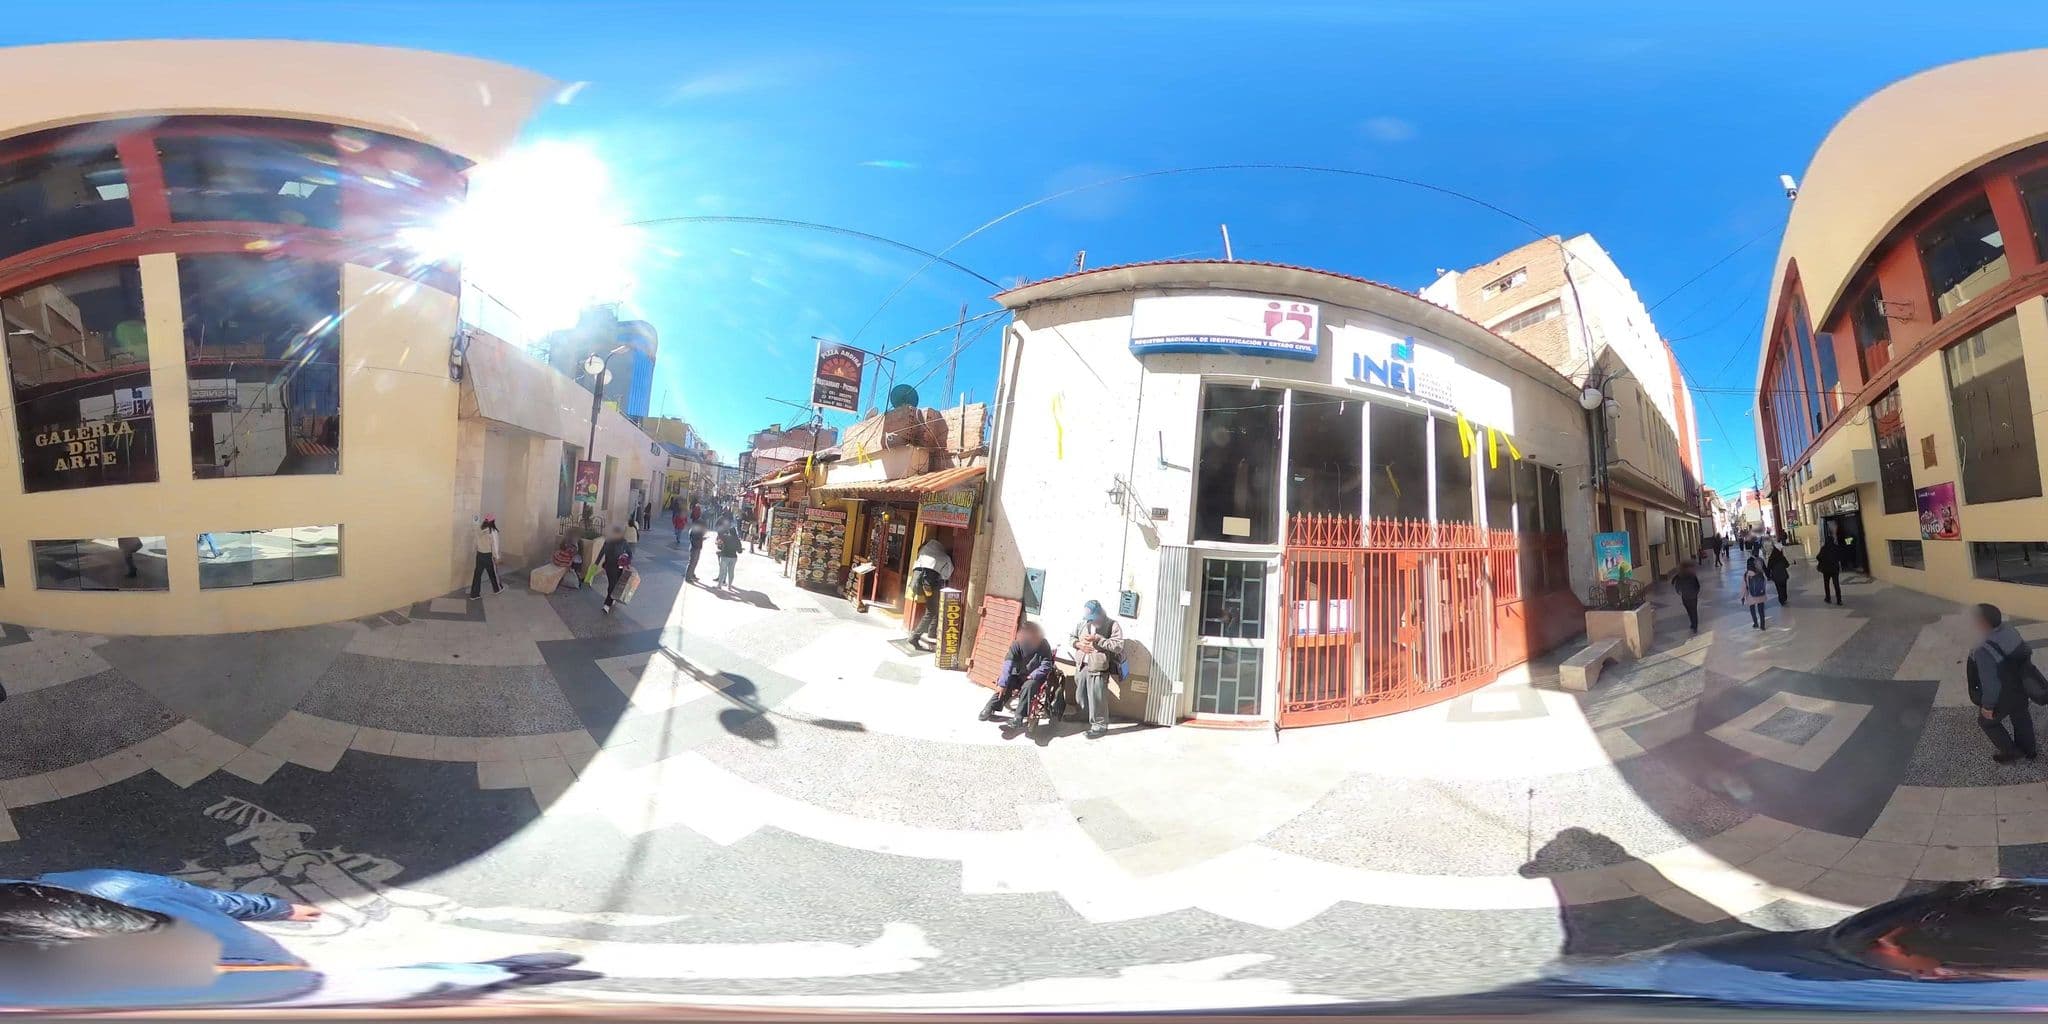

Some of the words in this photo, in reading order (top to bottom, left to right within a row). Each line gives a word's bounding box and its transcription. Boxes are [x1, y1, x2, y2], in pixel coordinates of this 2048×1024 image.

[1269, 340, 1294, 349] ESTADO
[821, 350, 839, 359] PIZZA
[840, 350, 861, 368] ANDINA
[1353, 352, 1415, 395] INEI
[35, 420, 134, 447] GALERIA
[68, 439, 98, 455] DE
[54, 451, 117, 471] ARTE
[946, 605, 960, 654] DOLARES
